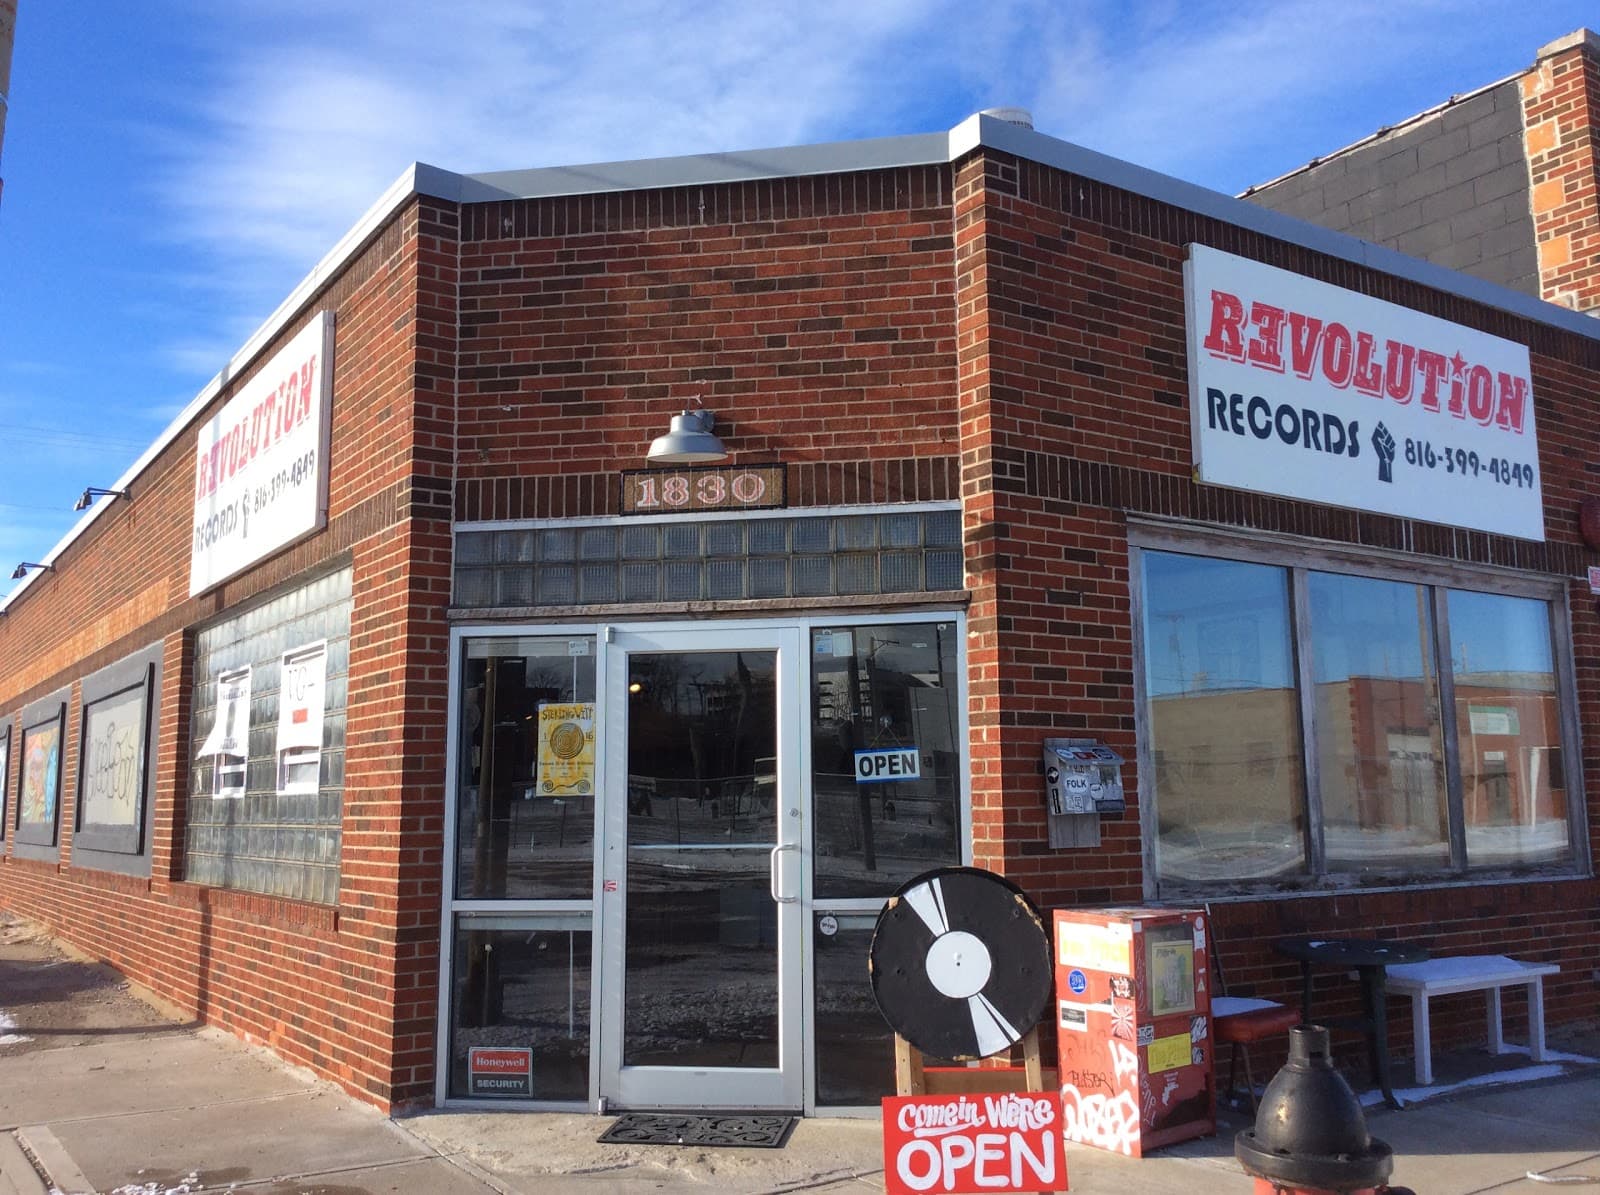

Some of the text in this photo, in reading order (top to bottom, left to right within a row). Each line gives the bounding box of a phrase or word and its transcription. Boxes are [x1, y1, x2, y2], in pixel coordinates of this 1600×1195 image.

[1206, 387, 1534, 489] RECORDS 816-399-4849
[195, 449, 316, 553] RECORDS 816-399-4849
[637, 473, 766, 508] 1830
[859, 753, 916, 777] OPEN
[1066, 779, 1087, 789] FOLK
[477, 1057, 525, 1068] Honeywell
[477, 1079, 525, 1089] SECURITY
[897, 1130, 1055, 1191] OPEN
